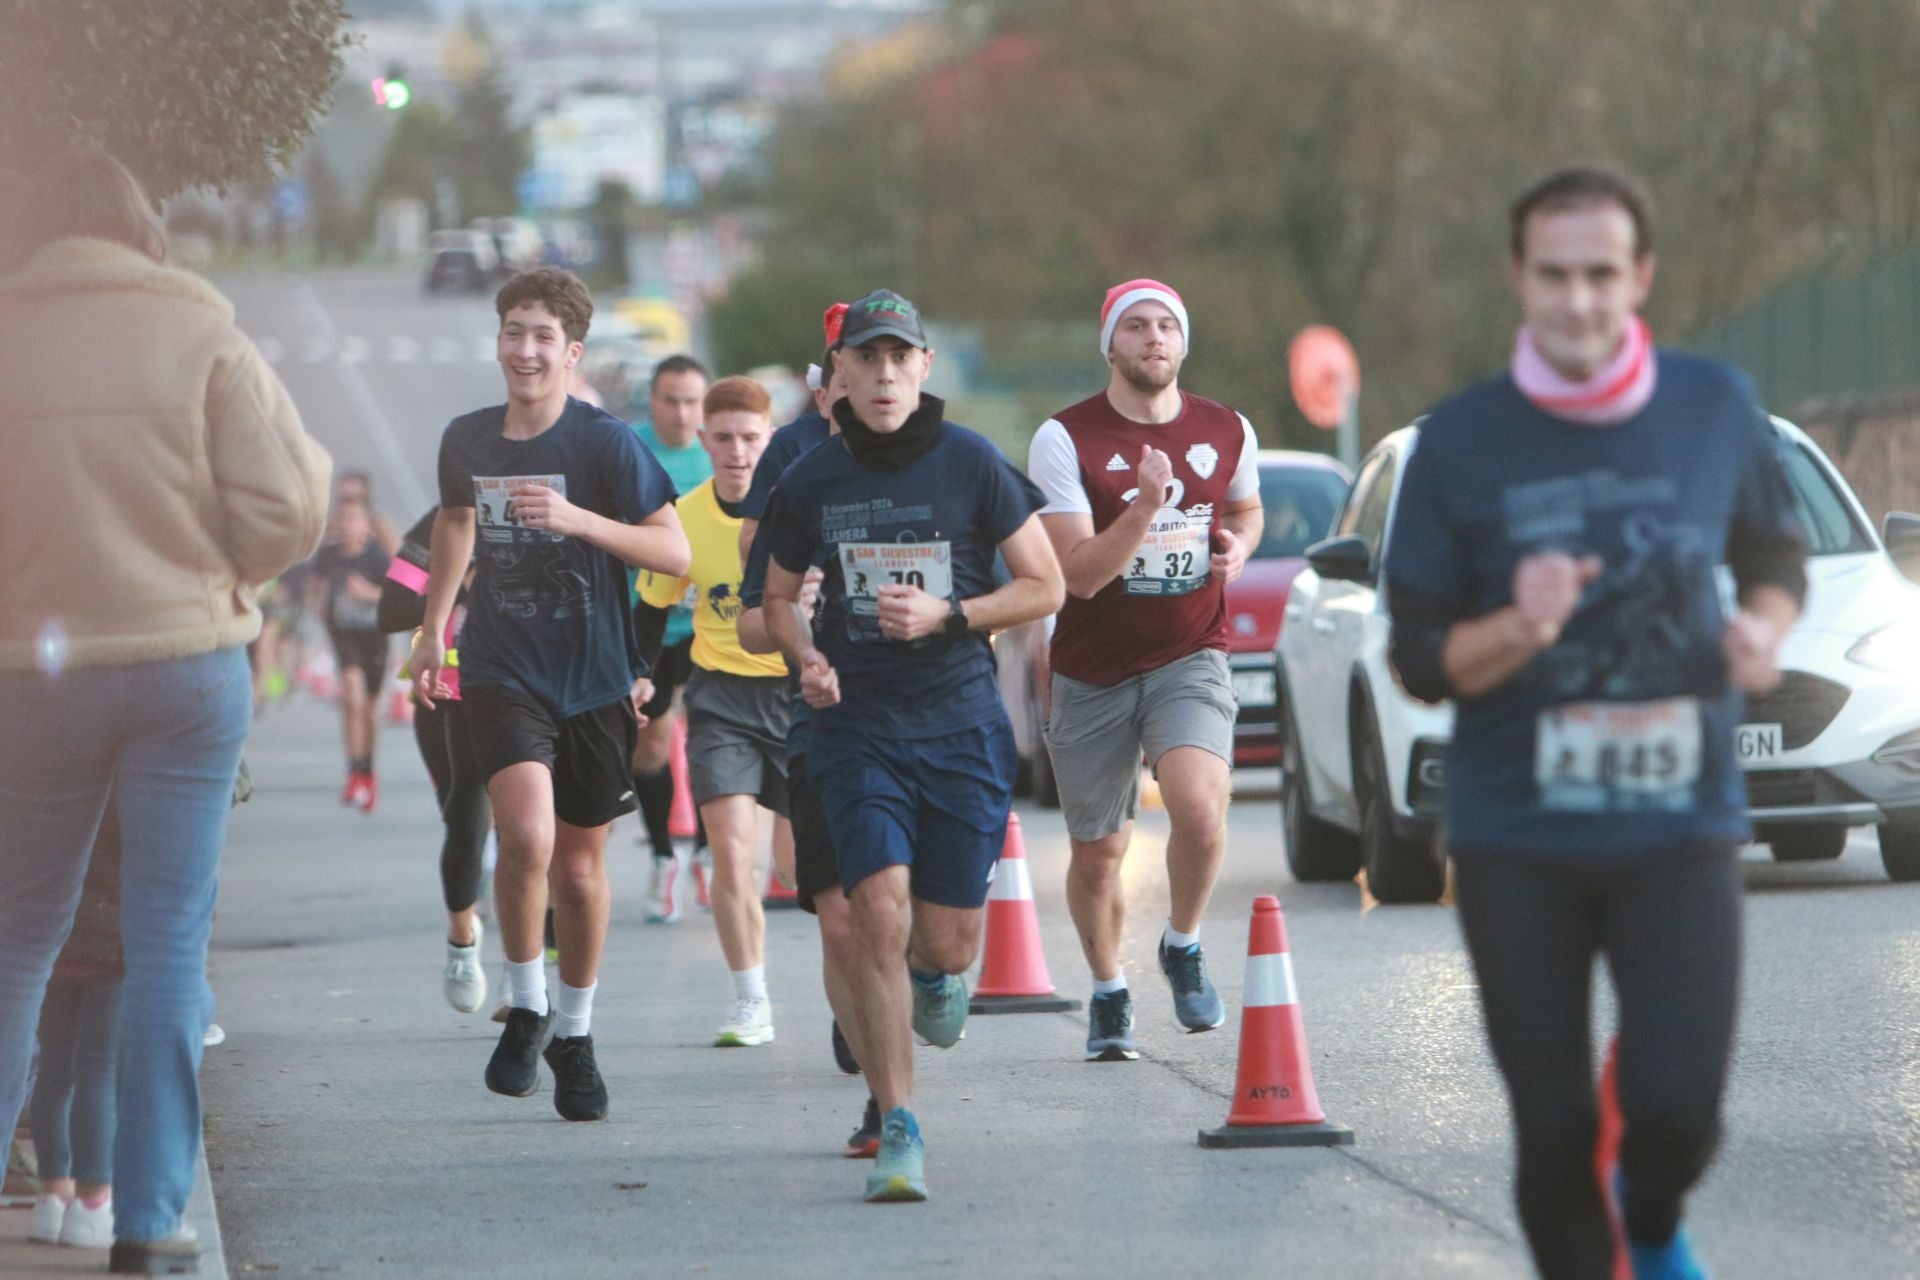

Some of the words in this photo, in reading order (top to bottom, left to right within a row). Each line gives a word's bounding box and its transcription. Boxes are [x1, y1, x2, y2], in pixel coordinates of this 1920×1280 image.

[855, 547, 877, 558] SAN
[880, 546, 934, 558] SILVESTRE
[1165, 551, 1193, 578] 32
